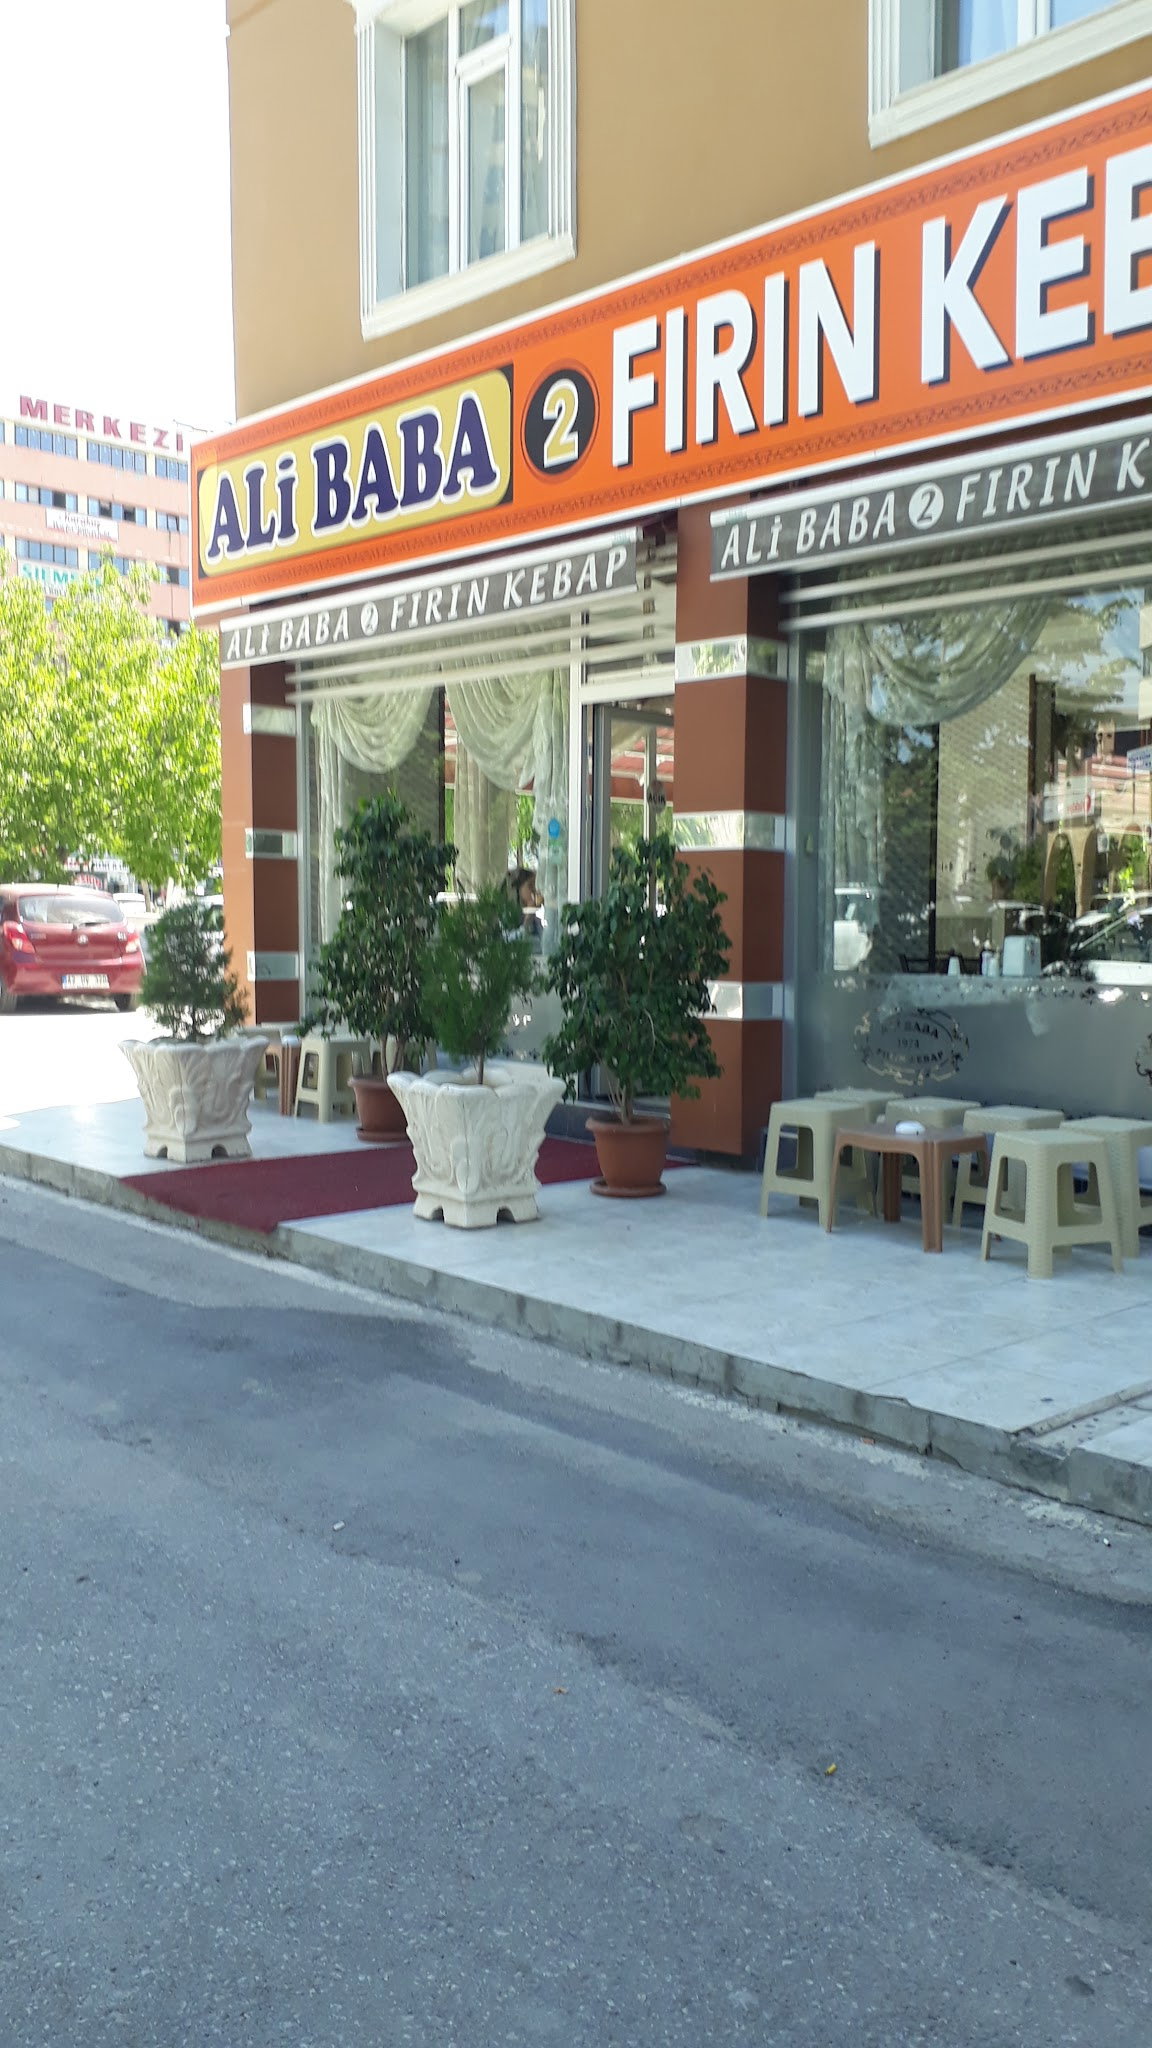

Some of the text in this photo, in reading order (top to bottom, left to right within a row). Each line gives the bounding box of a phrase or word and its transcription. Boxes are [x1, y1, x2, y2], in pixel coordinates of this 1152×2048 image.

[312, 392, 498, 534] BABA
[543, 379, 580, 468] 2
[612, 240, 880, 468] FIRIN
[796, 491, 896, 553] BABA
[956, 448, 1098, 523] FIRIN
[279, 607, 350, 653] BABA
[390, 578, 489, 632] FIRIN
[503, 545, 628, 610] KEBAP
